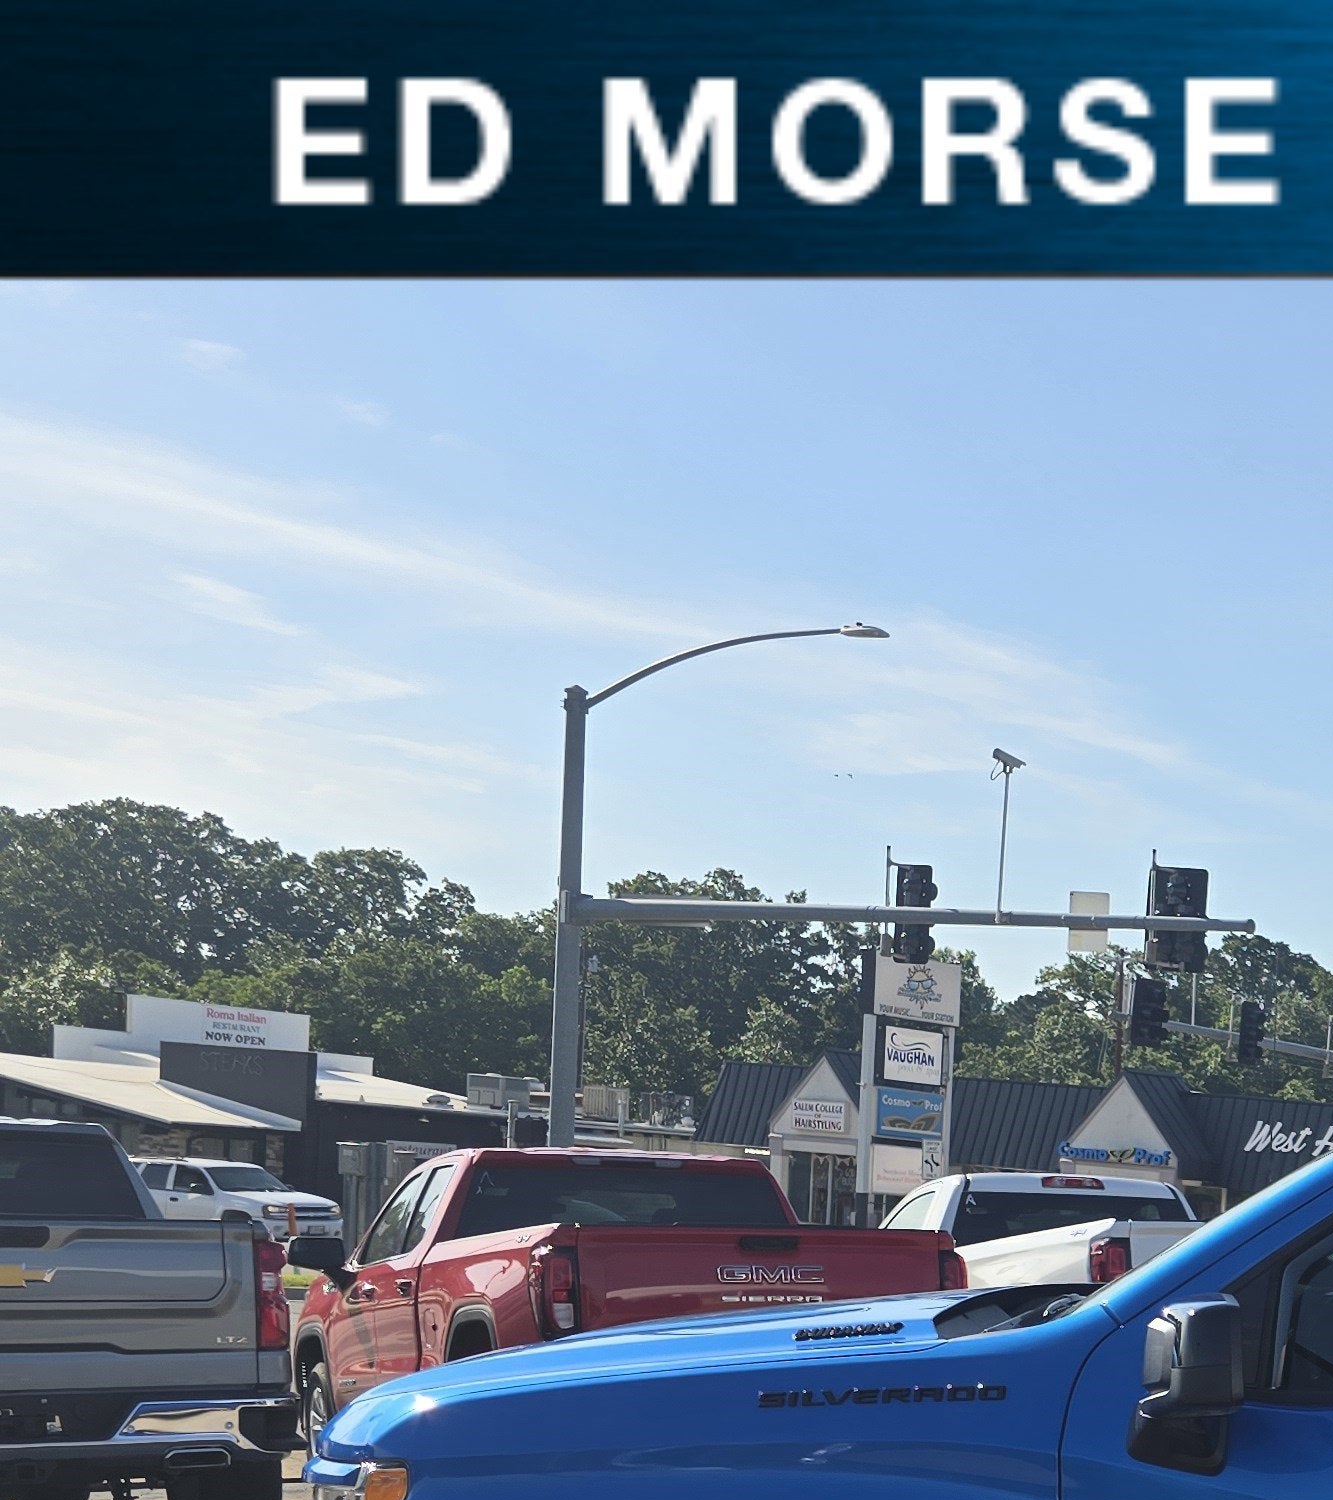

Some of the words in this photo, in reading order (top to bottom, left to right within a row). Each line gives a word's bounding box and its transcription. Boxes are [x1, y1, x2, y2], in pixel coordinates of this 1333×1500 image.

[206, 1007, 235, 1020] Roma
[237, 1011, 267, 1024] Italian
[213, 1021, 260, 1033] RESTAURANT
[205, 1031, 232, 1042] NOW
[235, 1034, 266, 1046] OPEN
[887, 1047, 935, 1067] VAUGHAN
[794, 1101, 813, 1111] SALEM
[815, 1103, 843, 1114] COLLEGE
[881, 1094, 911, 1108] Cosmo
[924, 1100, 943, 1112] Prof
[794, 1117, 842, 1131] HAIRSTYLING
[1244, 1120, 1313, 1153] West
[1059, 1141, 1110, 1161] Cosmo
[1134, 1147, 1172, 1166] Prof
[716, 1264, 824, 1283] GMC
[721, 1295, 823, 1304] SIERRA
[757, 1383, 1007, 1409] SILVERADO
